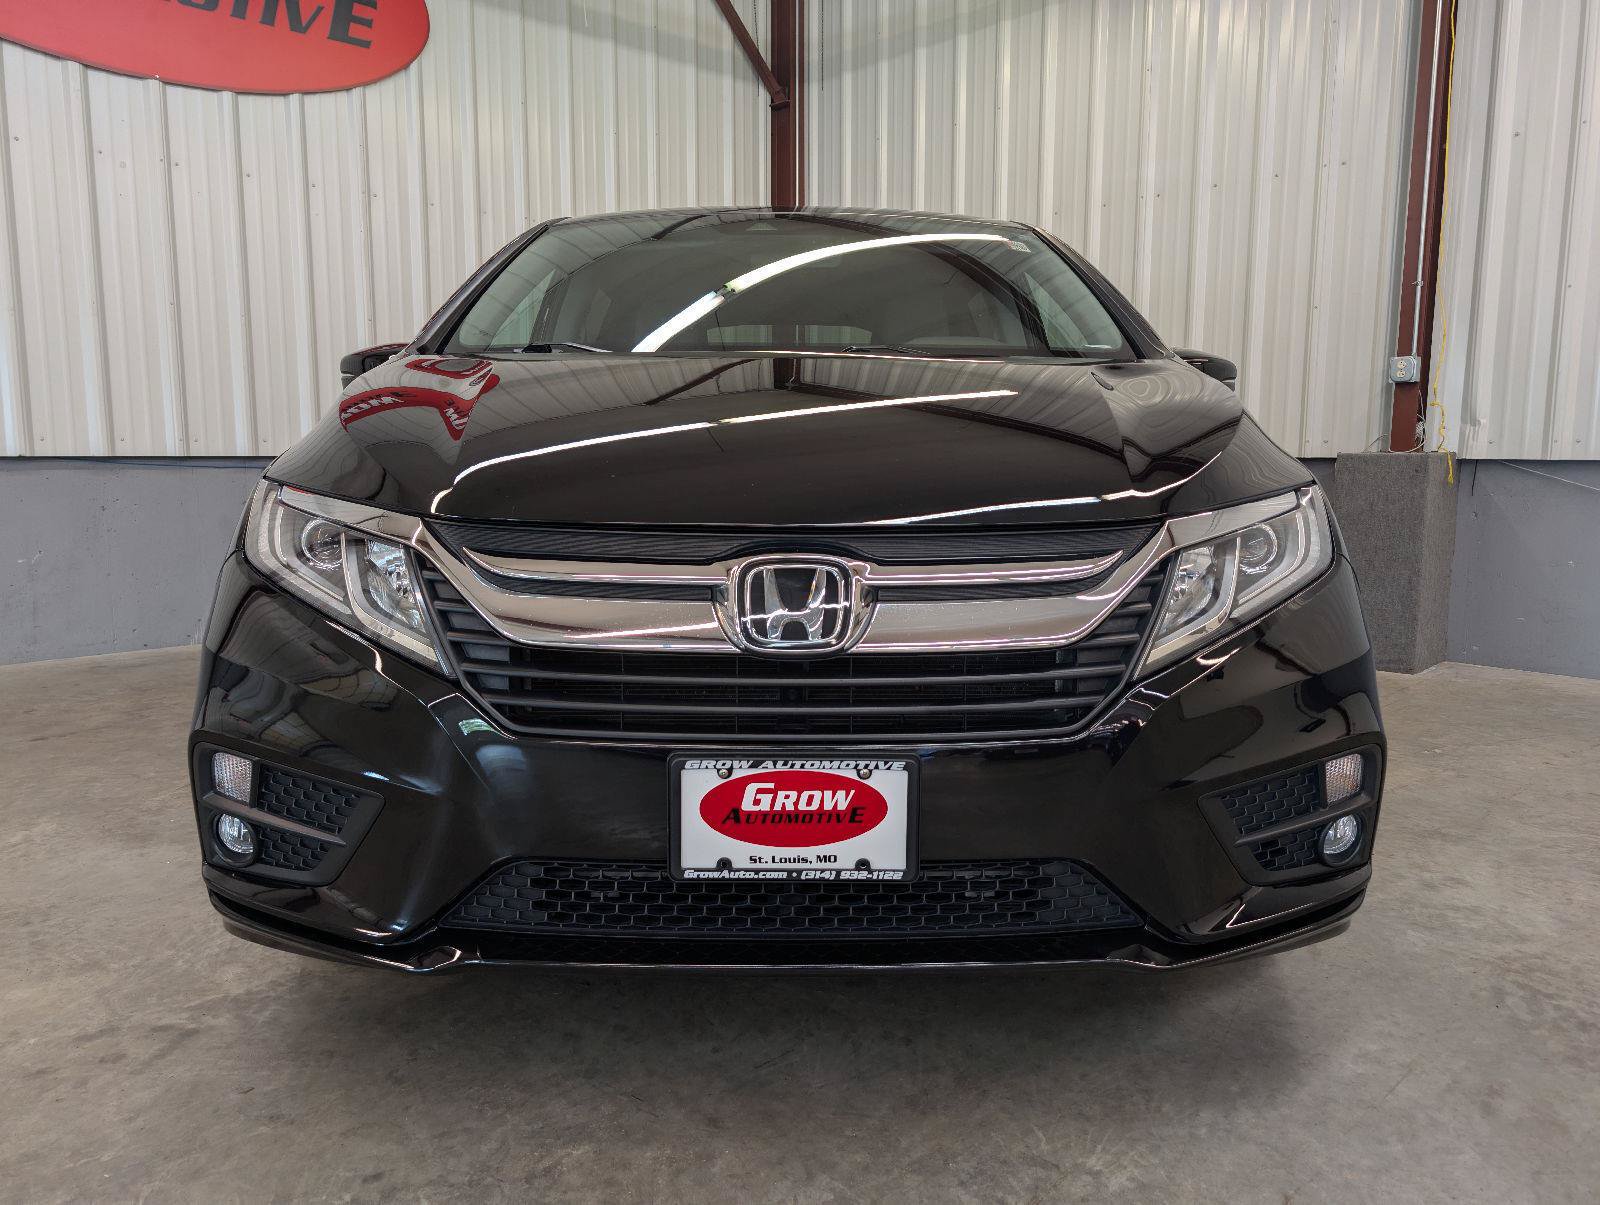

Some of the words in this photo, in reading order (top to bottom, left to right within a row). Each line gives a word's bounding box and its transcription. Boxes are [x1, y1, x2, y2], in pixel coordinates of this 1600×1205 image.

[684, 760, 754, 770] GROW
[758, 760, 906, 770] AUTOMOTIVE
[749, 855, 768, 864] St.
[771, 854, 813, 865] Louis,
[816, 854, 837, 864] MO
[683, 869, 787, 880] GrowAuto.com
[801, 869, 836, 880] (314)
[839, 869, 904, 880] 932-1122
